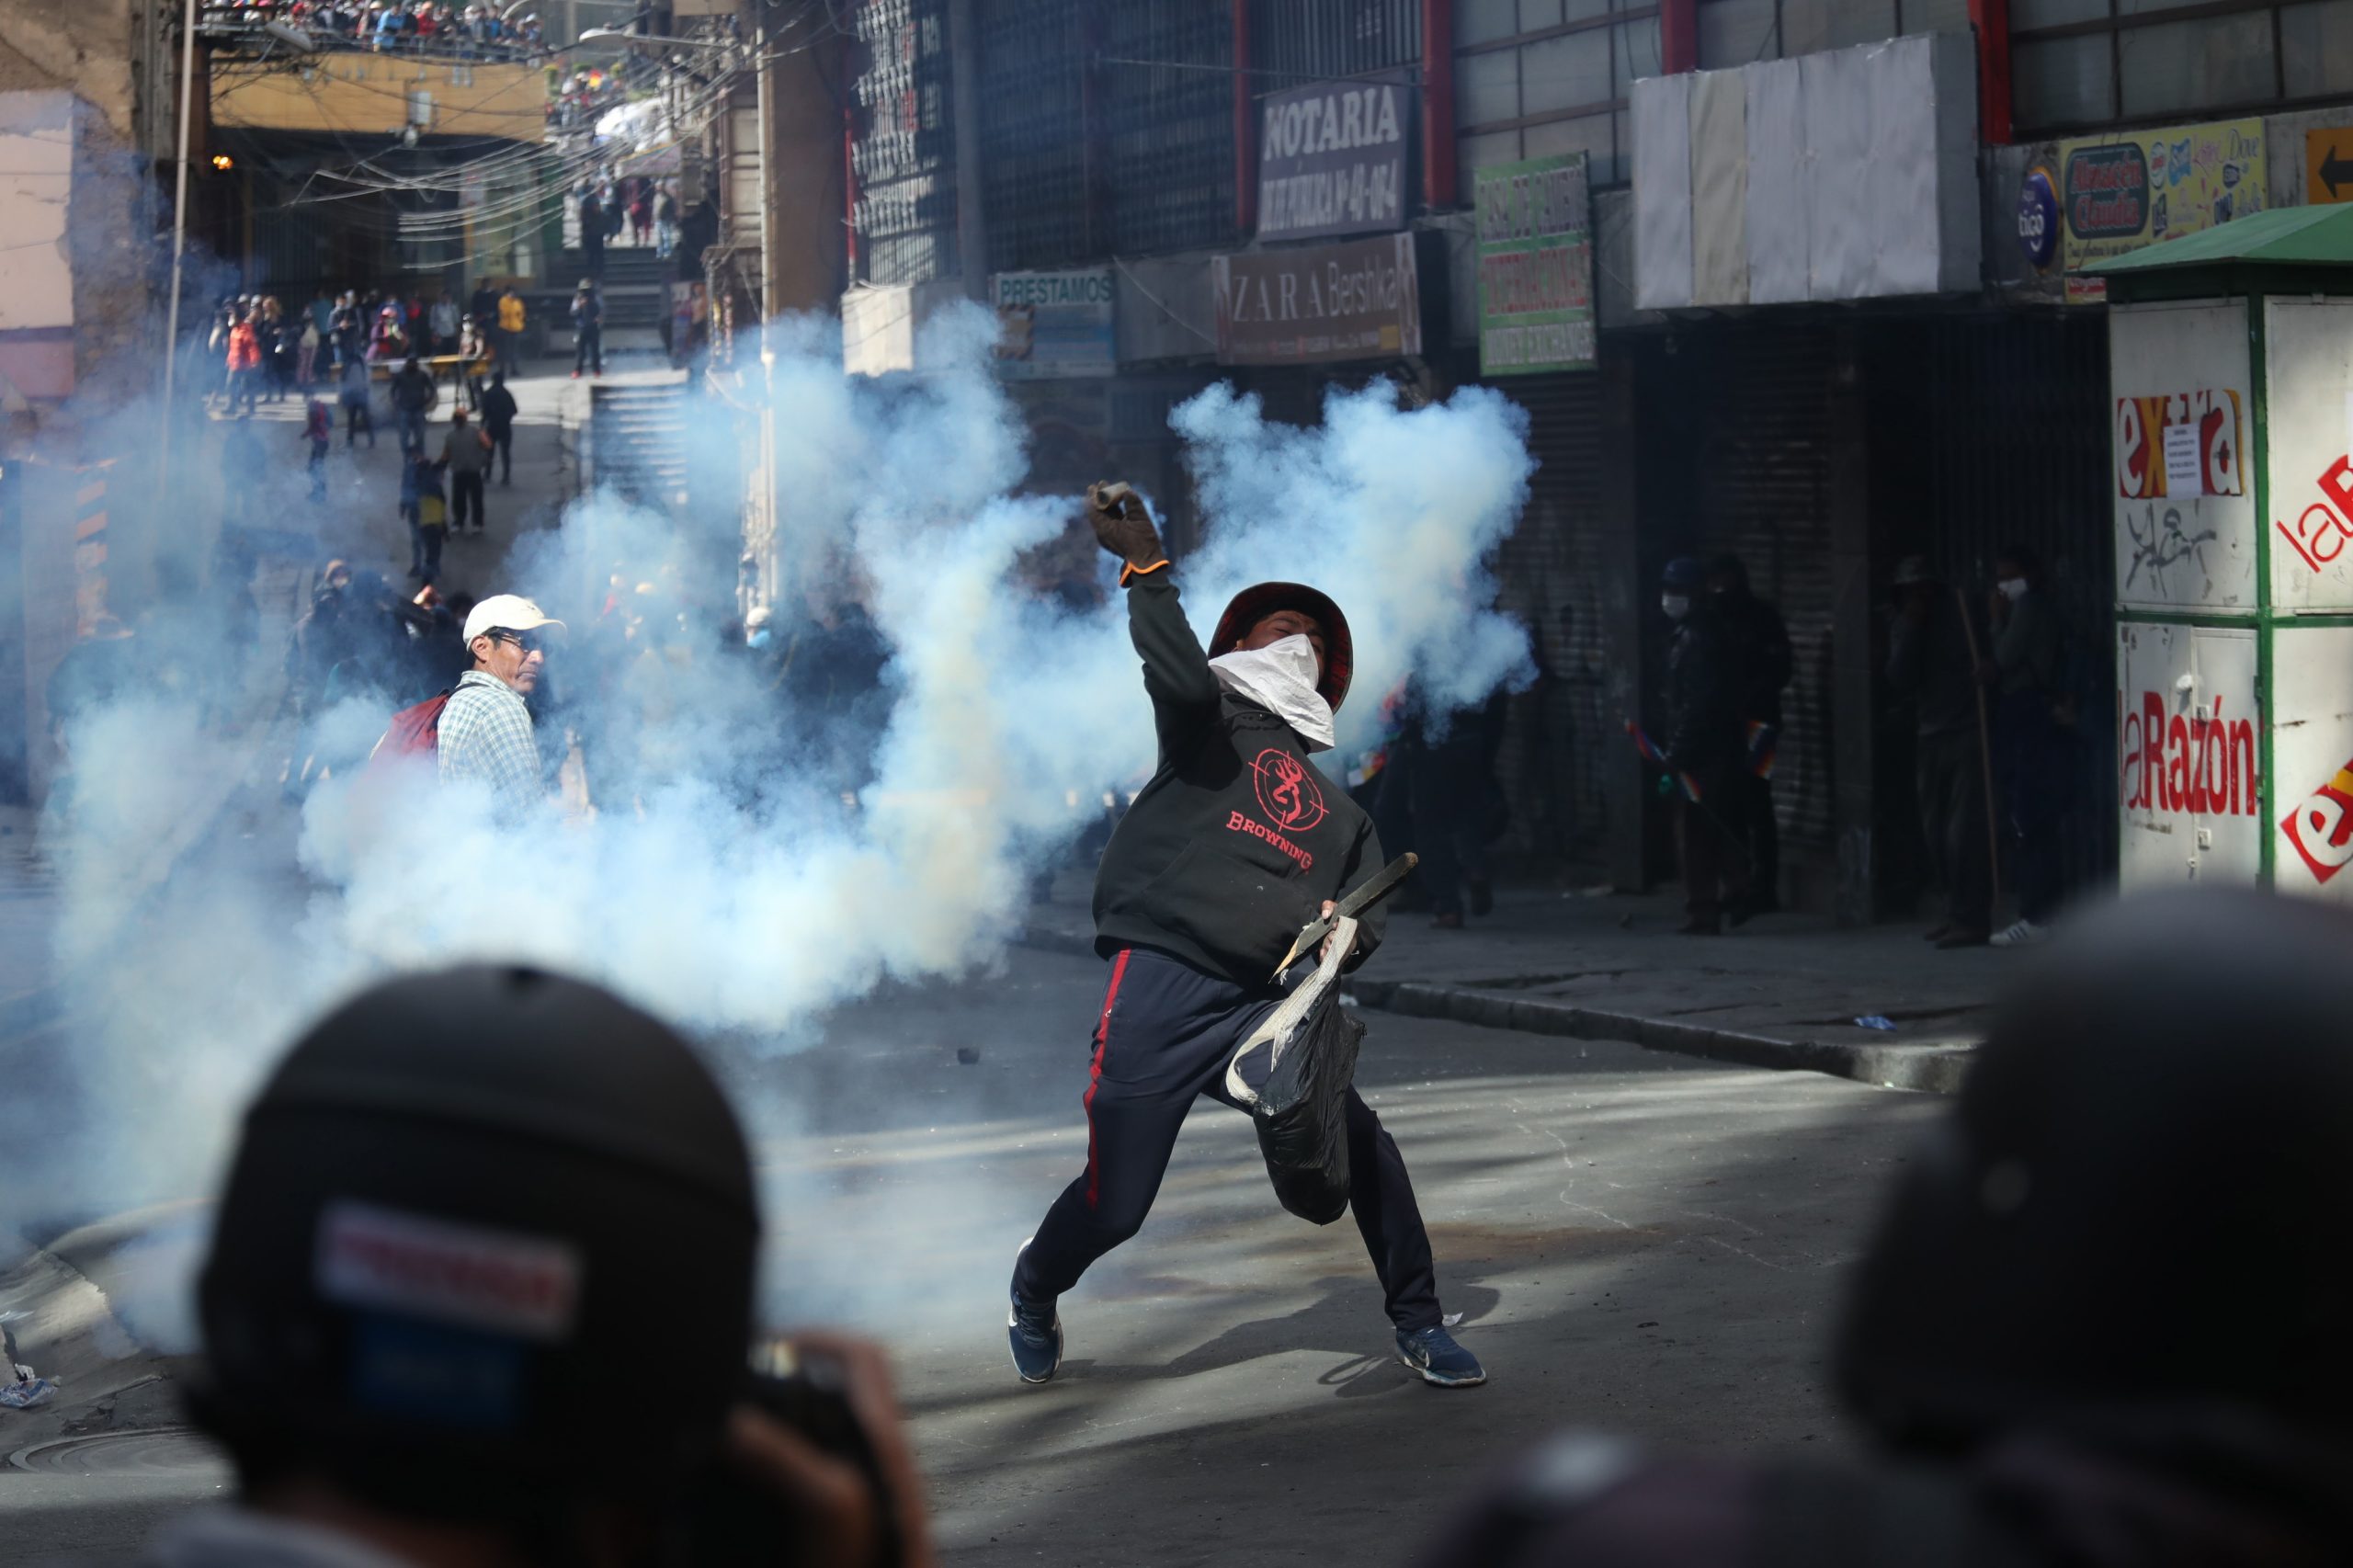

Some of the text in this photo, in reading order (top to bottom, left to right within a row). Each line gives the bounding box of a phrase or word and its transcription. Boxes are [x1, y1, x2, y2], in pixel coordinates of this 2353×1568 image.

[1264, 85, 1400, 162] NOTARIA
[2075, 192, 2140, 233] Claudia
[1000, 276, 1112, 305] PRESTAMOS
[1233, 259, 1398, 323] ZARA Bershka
[1225, 811, 1313, 870] BROWNING
